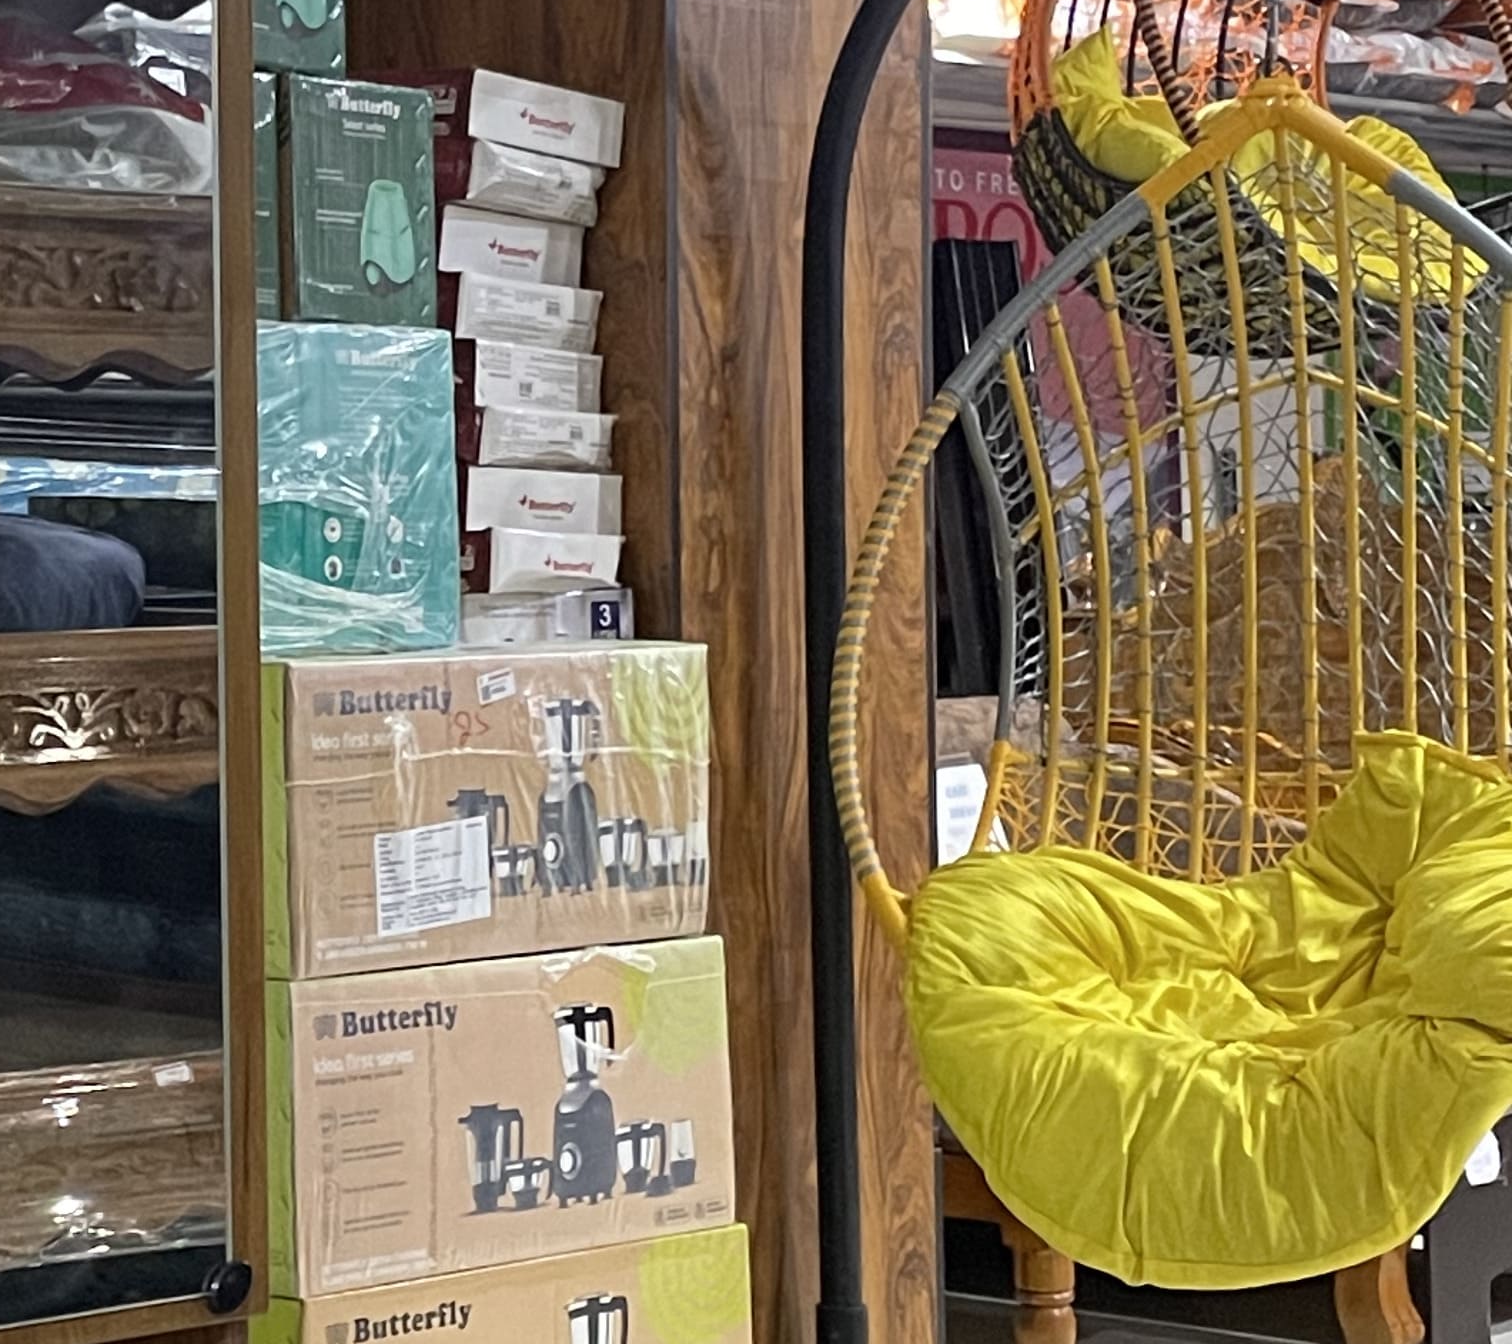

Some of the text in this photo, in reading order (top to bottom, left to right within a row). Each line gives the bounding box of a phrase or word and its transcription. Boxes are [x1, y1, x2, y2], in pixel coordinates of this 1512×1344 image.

[340, 94, 401, 119] Butterfly
[934, 168, 964, 192] TO
[598, 603, 612, 627] 3
[339, 685, 452, 715] Butterfly
[341, 1001, 458, 1037] Butterfly
[353, 1300, 472, 1344] Butterfly
